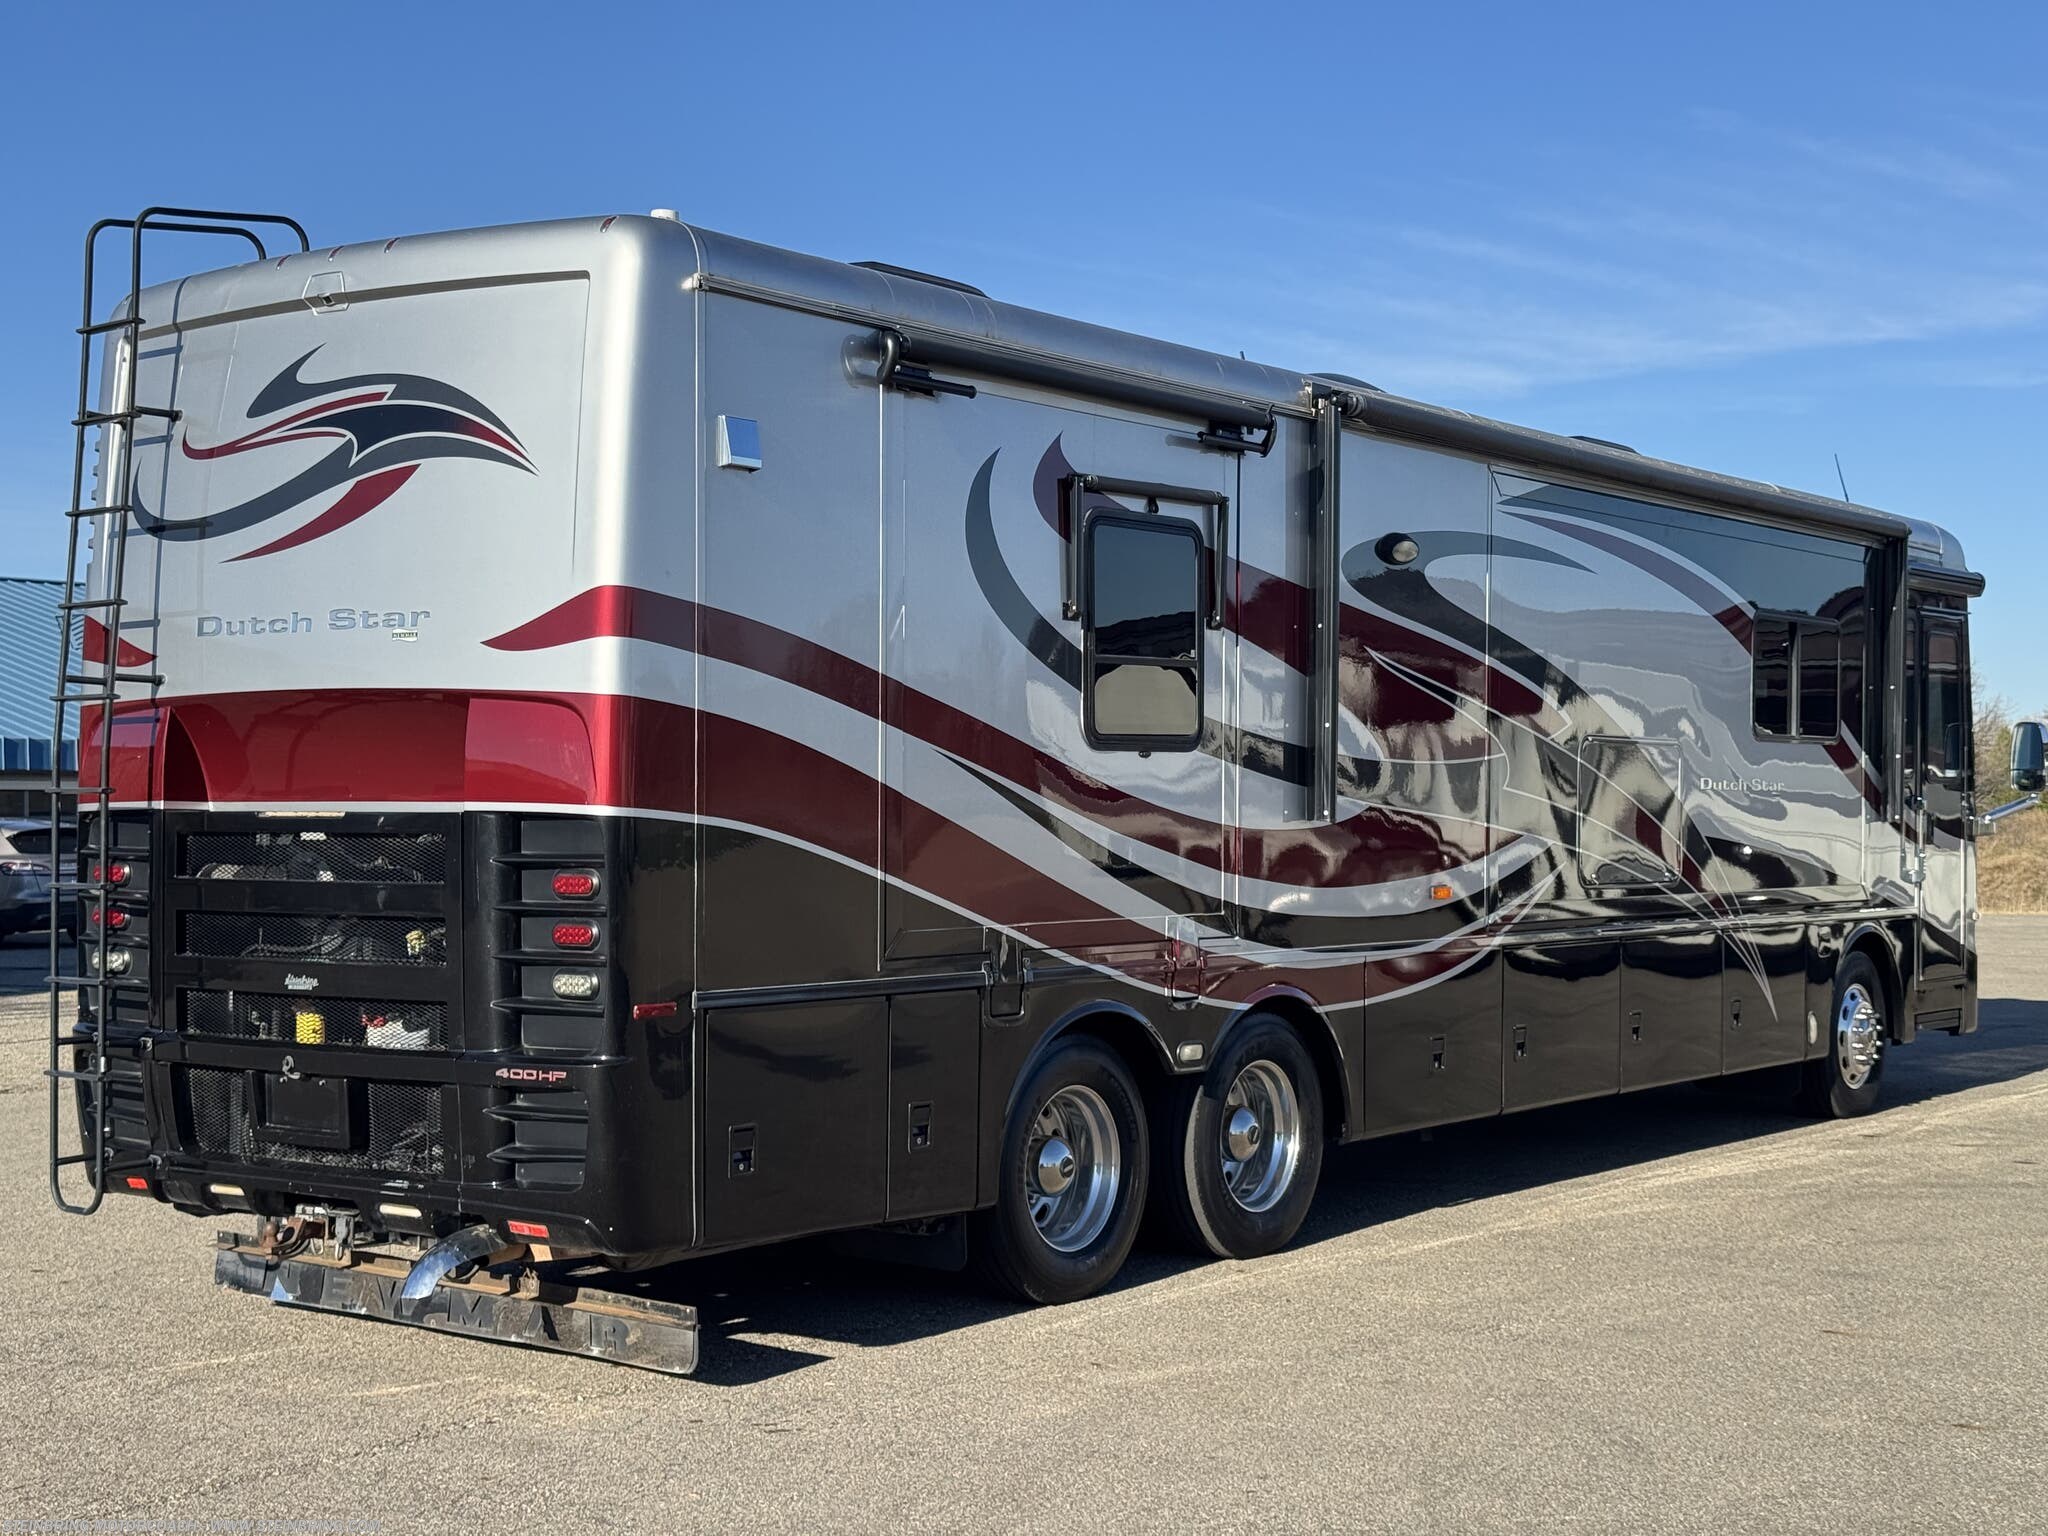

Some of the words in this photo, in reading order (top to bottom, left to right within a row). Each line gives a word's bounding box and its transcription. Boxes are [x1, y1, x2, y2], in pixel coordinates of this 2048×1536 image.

[197, 611, 312, 638] Dutch
[328, 608, 432, 631] Star
[1699, 777, 1747, 791] Dutch
[1751, 778, 1785, 792] Star
